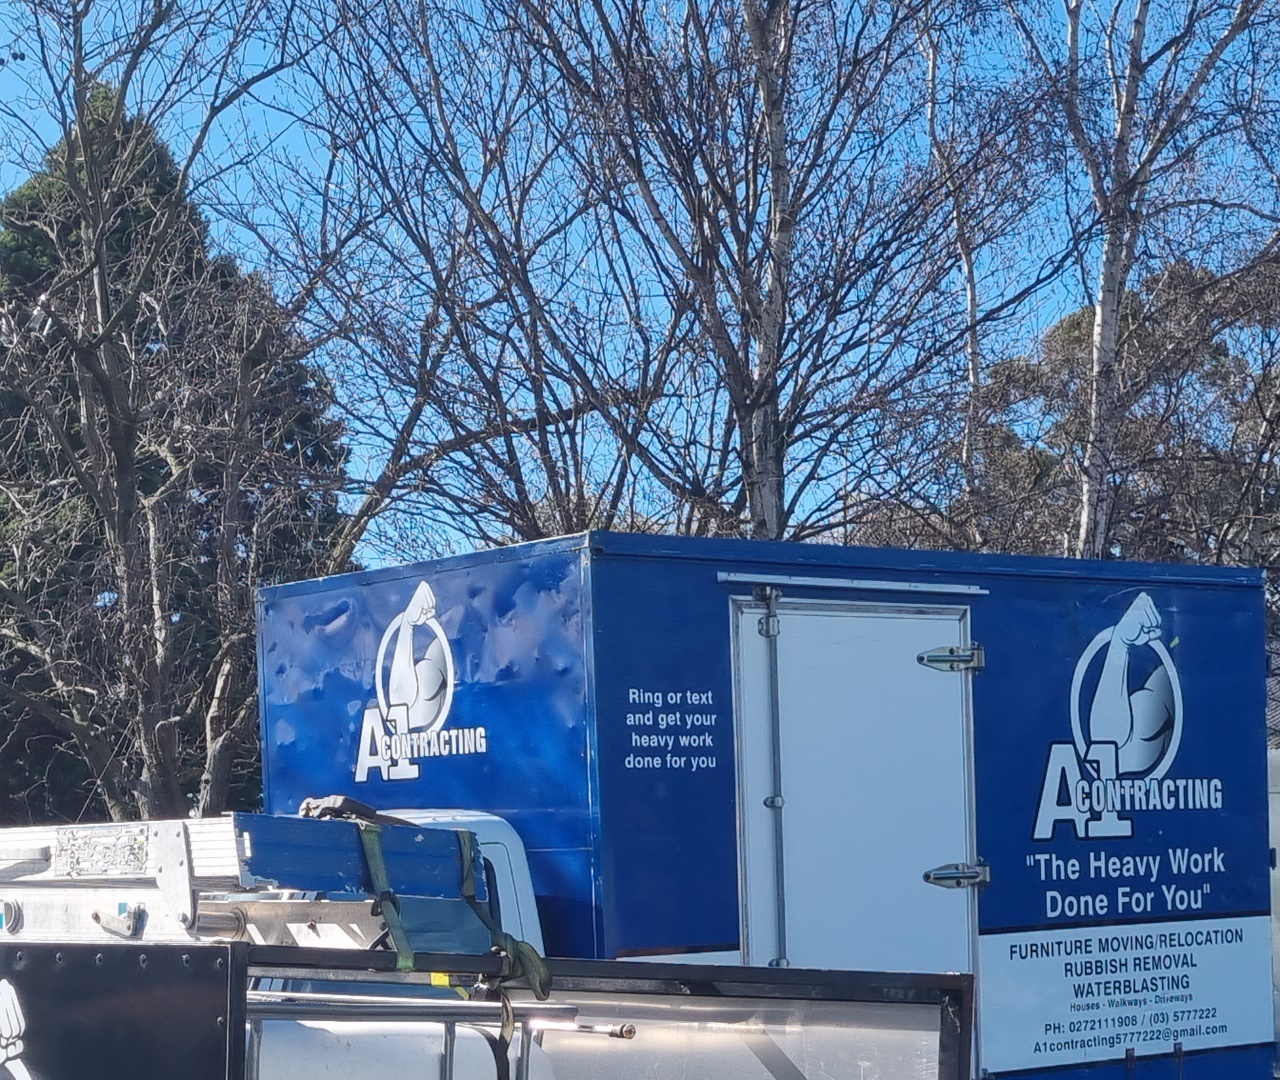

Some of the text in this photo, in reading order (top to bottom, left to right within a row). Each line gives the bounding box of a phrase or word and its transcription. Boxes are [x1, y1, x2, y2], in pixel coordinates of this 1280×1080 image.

[629, 688, 713, 707] Ring or text
[626, 712, 717, 729] and get your
[355, 704, 486, 782] A1 CONTRACTING
[632, 732, 713, 750] heavy work
[625, 754, 716, 772] done for you
[1033, 742, 1222, 839] A1 CONTRACTING
[1027, 847, 1225, 883] "The Heavy Work
[1046, 883, 1210, 918] Done For You"
[1009, 928, 1243, 960] FURNITURE MOVING/RELOCATION
[1064, 953, 1197, 978] RUBBISH REMOVAL
[1073, 974, 1190, 999] WATERBLASTING
[1070, 1001, 1101, 1012] Houses
[1107, 996, 1147, 1010] Walkways
[1044, 1023, 1065, 1035] PH:
[1069, 1015, 1137, 1033] 0272111908
[1149, 1011, 1170, 1028] (03)
[1173, 1007, 1217, 1023] 5777222
[1034, 1022, 1228, 1054] A1contracting5777222@gmail.com
